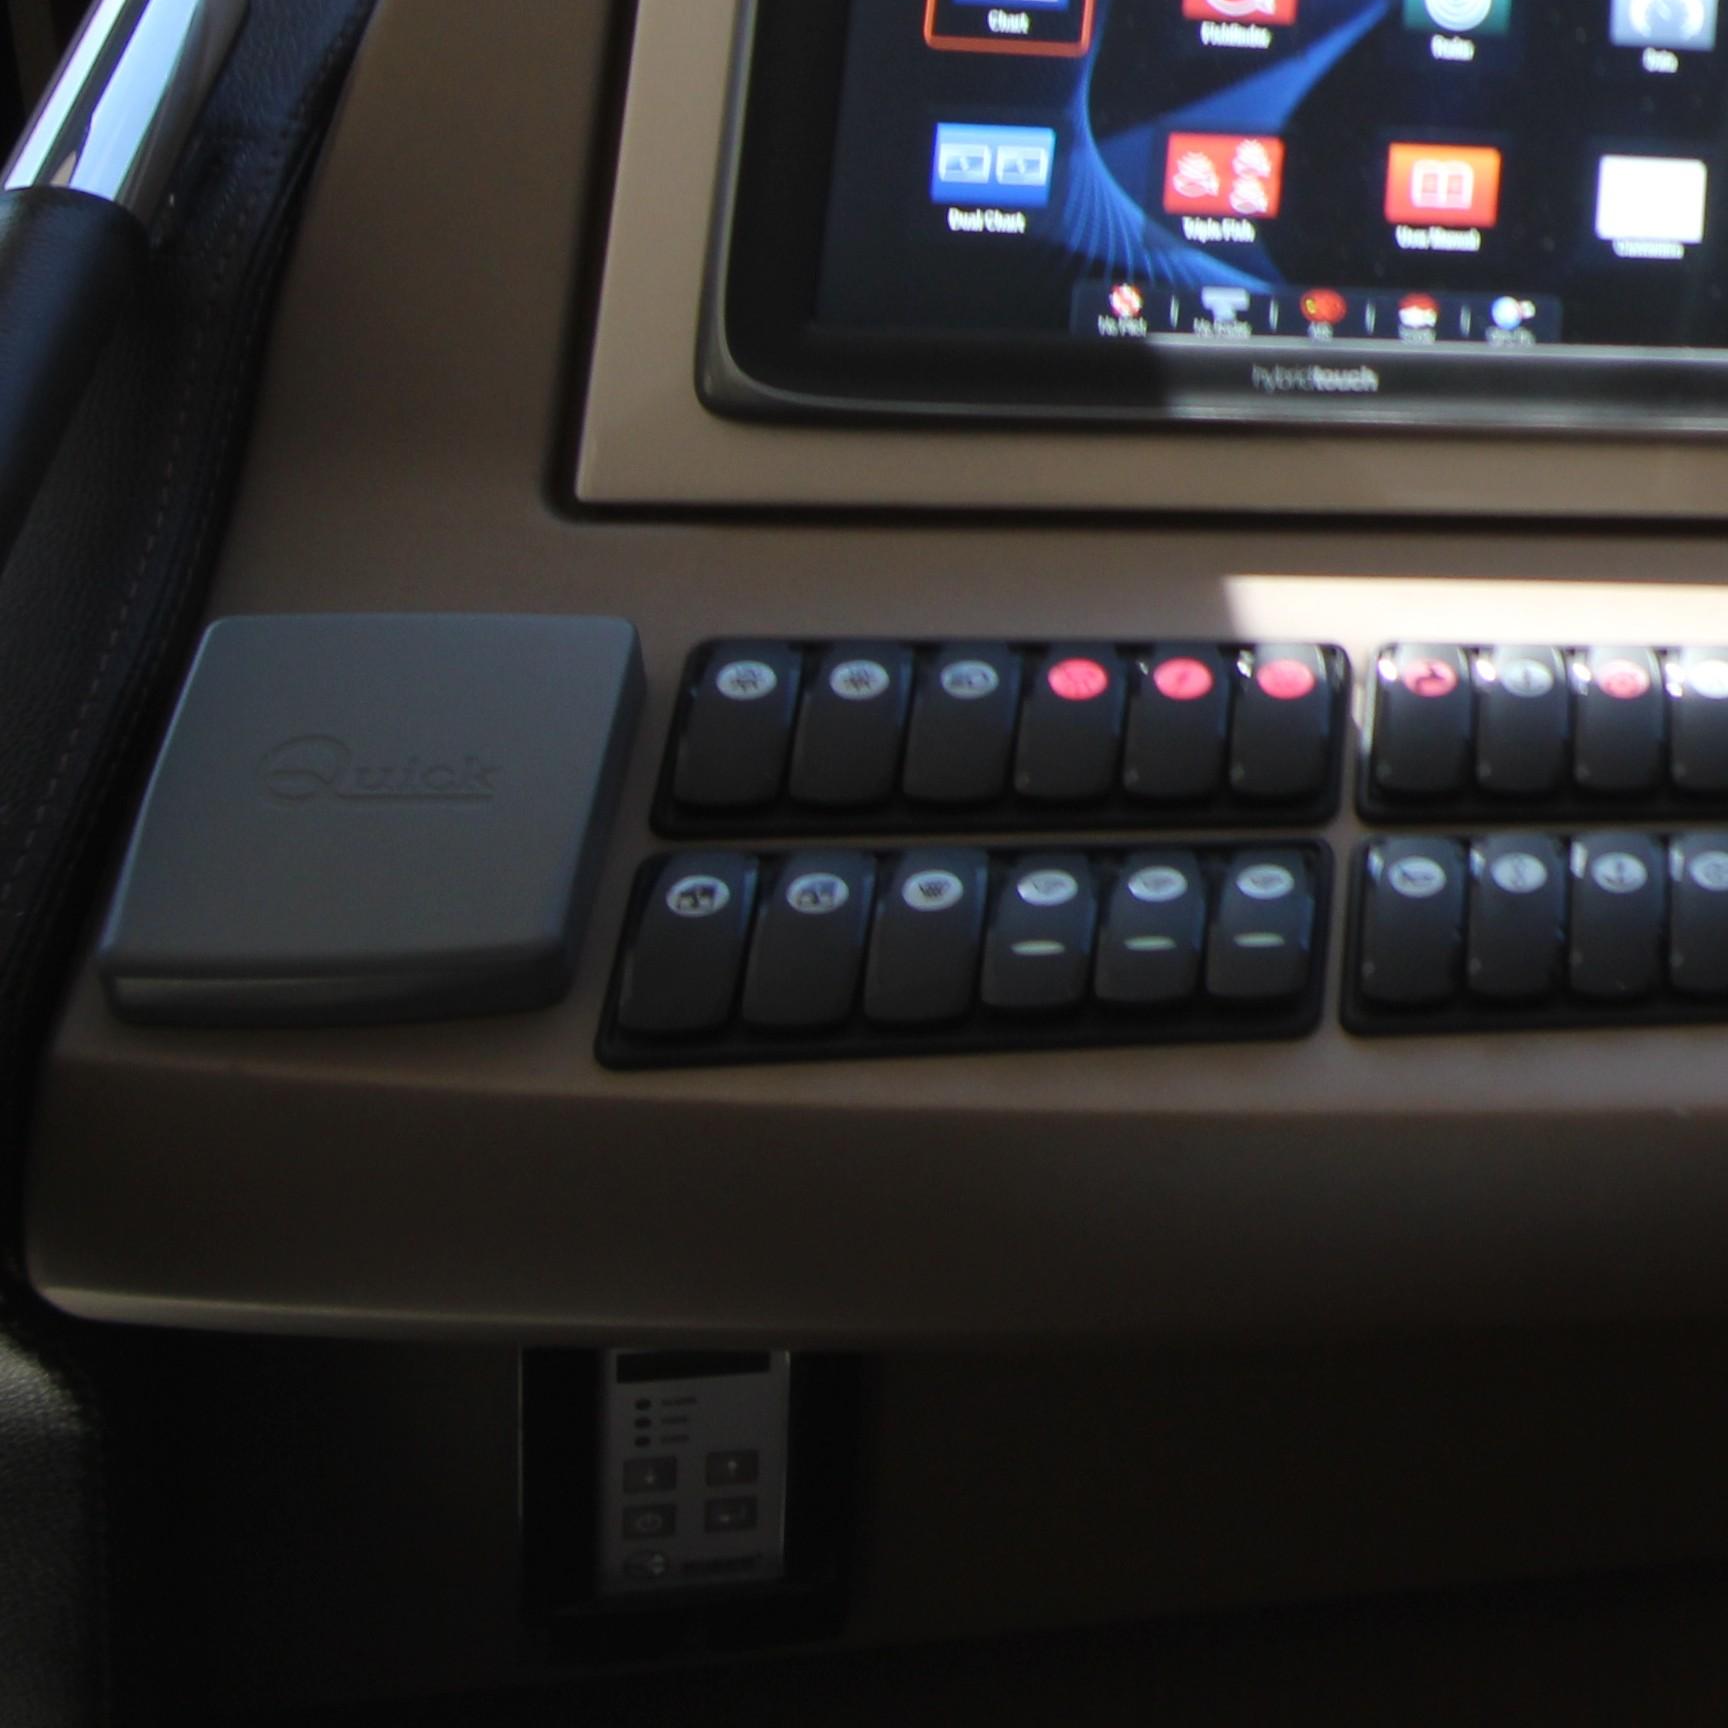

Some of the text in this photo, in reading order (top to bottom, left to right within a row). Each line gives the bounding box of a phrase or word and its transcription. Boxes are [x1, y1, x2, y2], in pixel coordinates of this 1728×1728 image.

[987, 8, 1031, 36] Chart
[947, 207, 1026, 235] Dual Chart
[1181, 216, 1256, 244] Triple Fish
[261, 734, 500, 802] Quick
